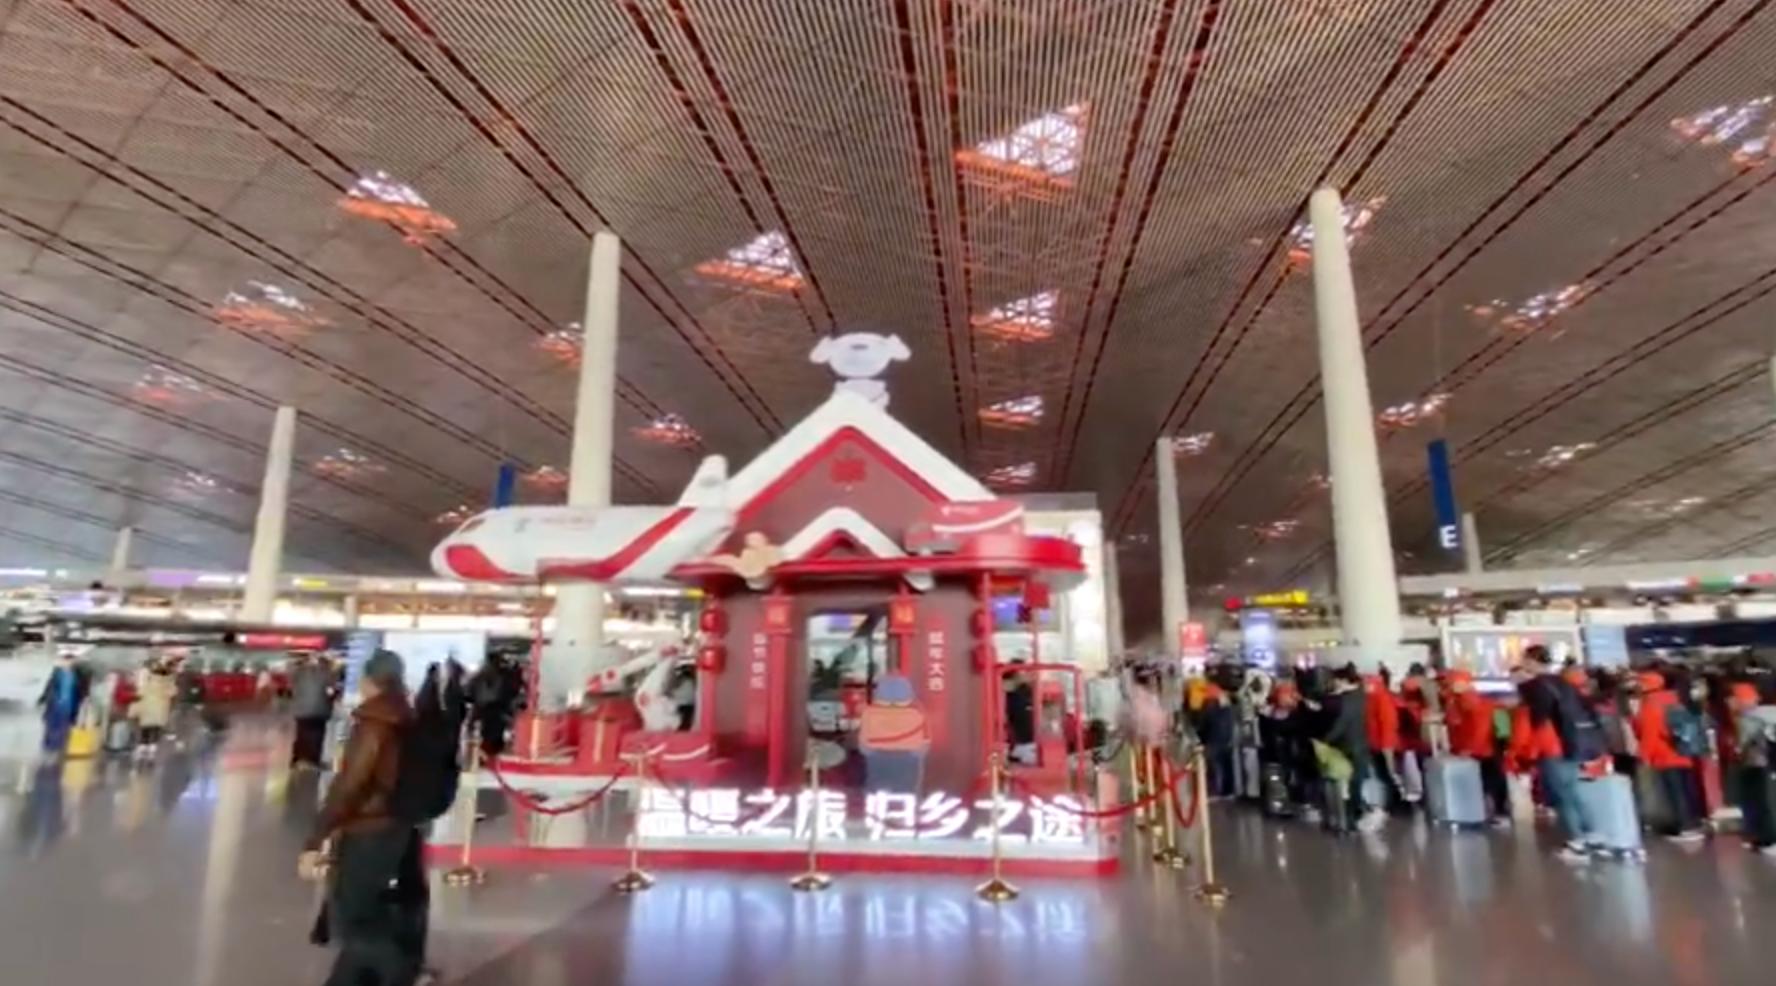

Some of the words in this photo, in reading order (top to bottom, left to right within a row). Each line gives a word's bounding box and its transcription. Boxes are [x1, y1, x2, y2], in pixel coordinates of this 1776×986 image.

[1440, 525, 1457, 549] E
[864, 790, 1084, 843] 归乡之途
